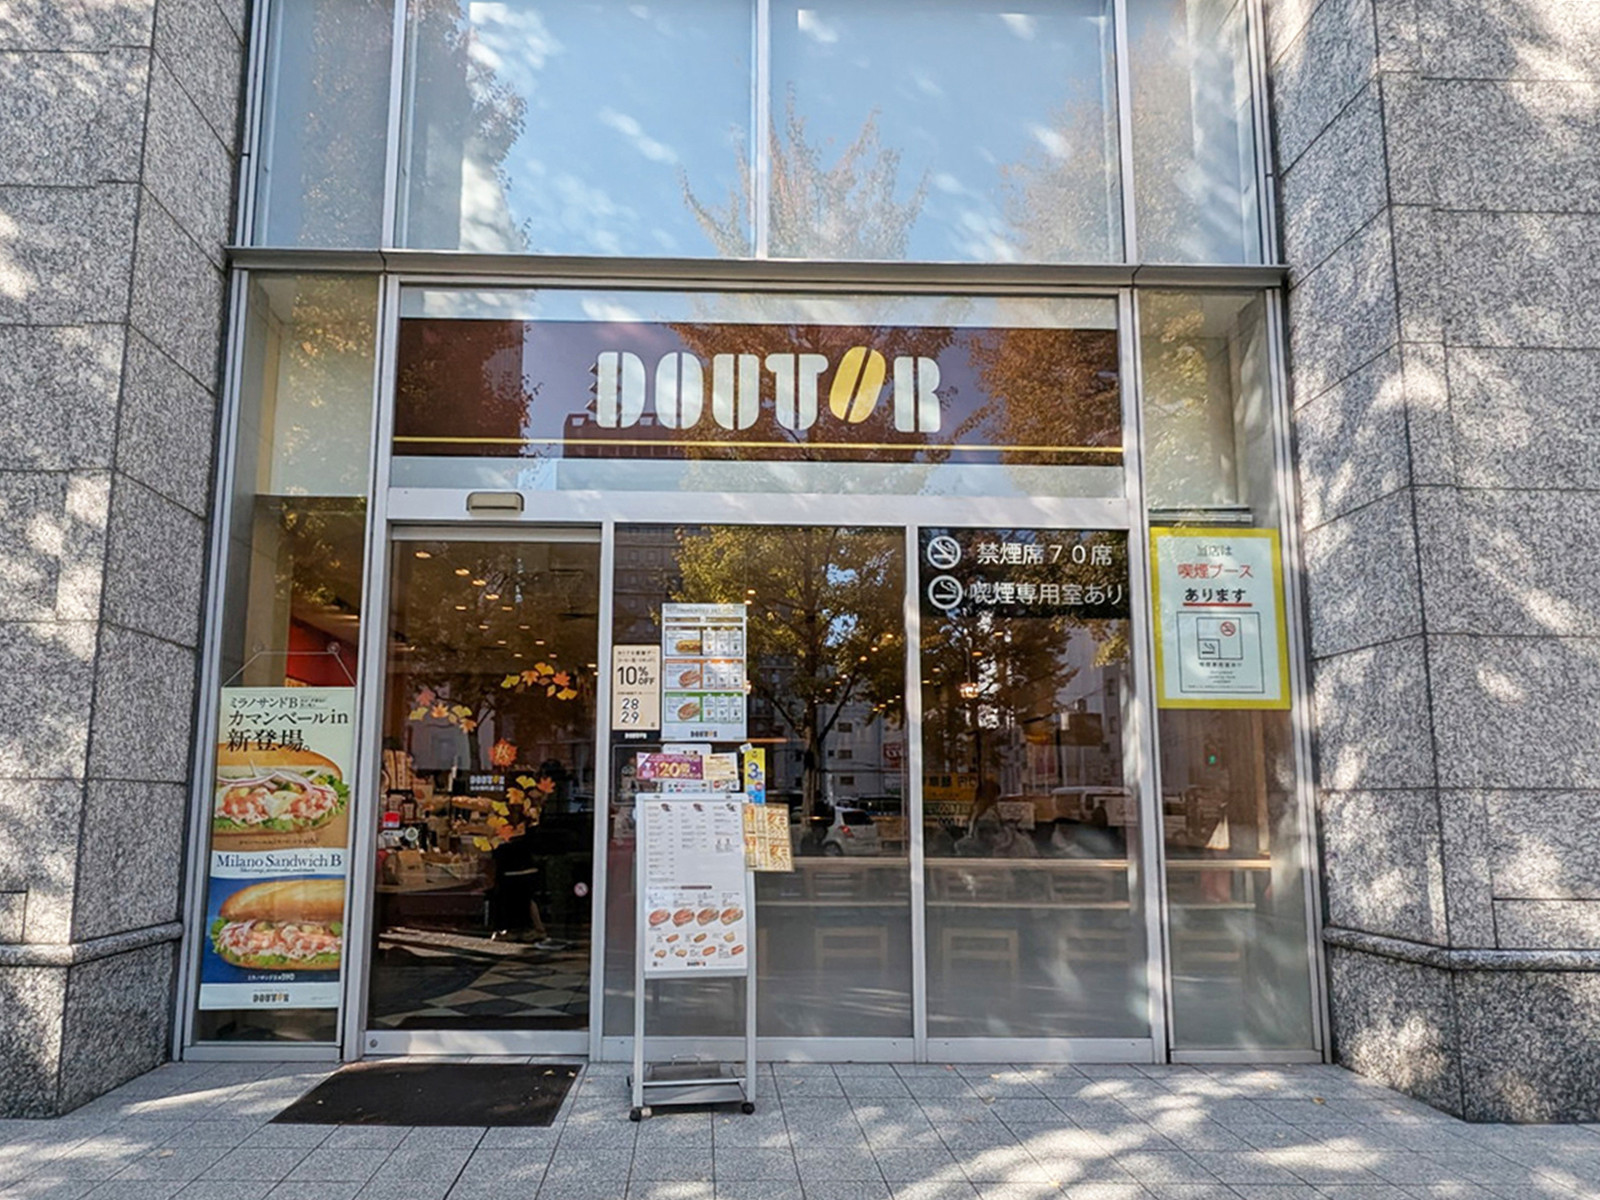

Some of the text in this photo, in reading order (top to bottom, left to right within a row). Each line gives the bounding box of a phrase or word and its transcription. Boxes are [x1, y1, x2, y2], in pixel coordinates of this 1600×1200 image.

[597, 346, 941, 433] DOUTOR
[1177, 563, 1254, 579] 喫煙ブース
[968, 581, 1122, 606] 喫煙専用室あり
[1184, 588, 1247, 602] あります
[230, 697, 298, 709] ミラノサンドB
[622, 698, 640, 710] 28
[228, 708, 349, 726] カマンベールin
[621, 711, 640, 723] 29
[226, 728, 311, 752] 新登場。
[217, 853, 342, 867] Milano Sandwich B
